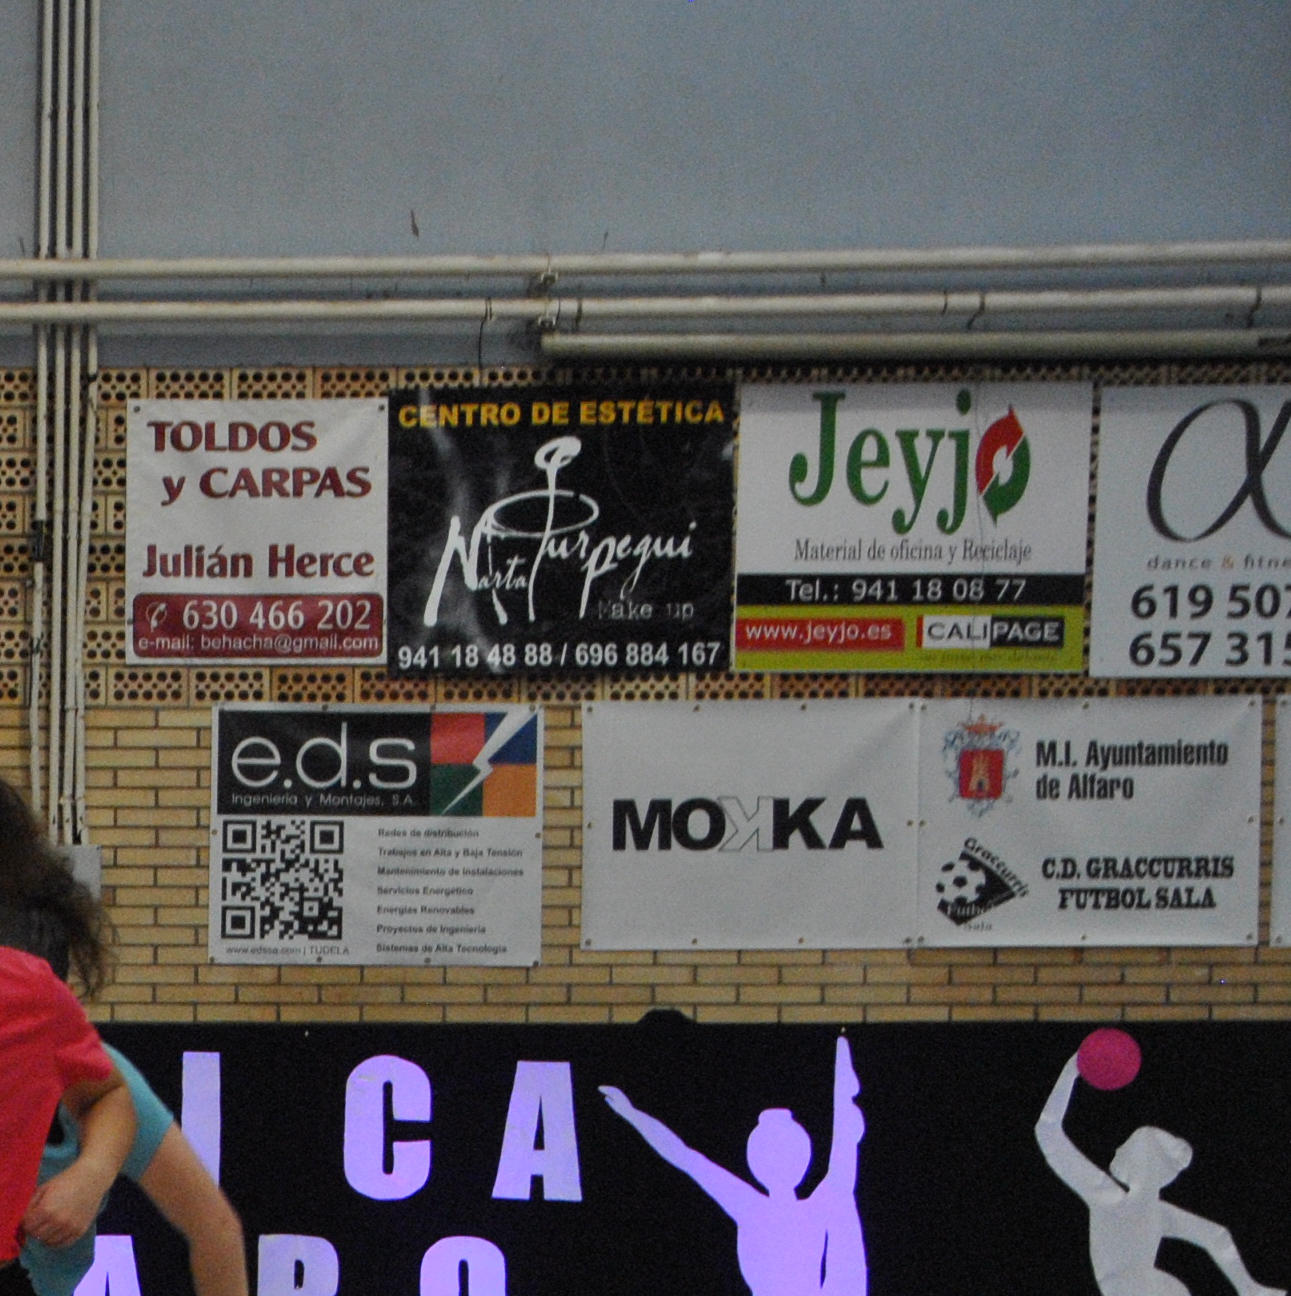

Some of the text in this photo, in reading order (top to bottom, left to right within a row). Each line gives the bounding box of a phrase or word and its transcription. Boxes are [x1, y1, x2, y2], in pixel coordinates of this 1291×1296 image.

[398, 404, 521, 428] CENTRO
[531, 402, 569, 425] DE
[147, 420, 318, 452] TOLDOS
[161, 466, 373, 507] y CARPAS
[142, 543, 375, 578] Julián Herce
[795, 538, 1032, 565] Material de oficina y Reciclaje
[1147, 554, 1212, 570] dance
[785, 579, 1027, 600] Tel.: 941 18 08 77
[1131, 583, 1215, 620] 619
[182, 599, 371, 630] 630 466 202
[598, 602, 653, 620] Make
[138, 634, 194, 650] e-mail:
[746, 620, 891, 644] www.jeyjo.es
[398, 647, 441, 669] 941
[451, 646, 479, 668] 18
[487, 645, 516, 668] 48
[524, 643, 553, 667] 88
[575, 643, 618, 666] 696
[625, 643, 669, 666] 884
[678, 642, 720, 666] 167
[1129, 630, 1212, 668] 657
[231, 721, 418, 789] e.d.s
[1085, 740, 1229, 771] Ayuntamiento
[1035, 773, 1134, 799] de Alfaro
[305, 796, 313, 807] y
[410, 828, 421, 837] de
[1041, 857, 1235, 879] C.D. GRACCURRIS
[1057, 887, 1216, 909] FUTBOL SALA
